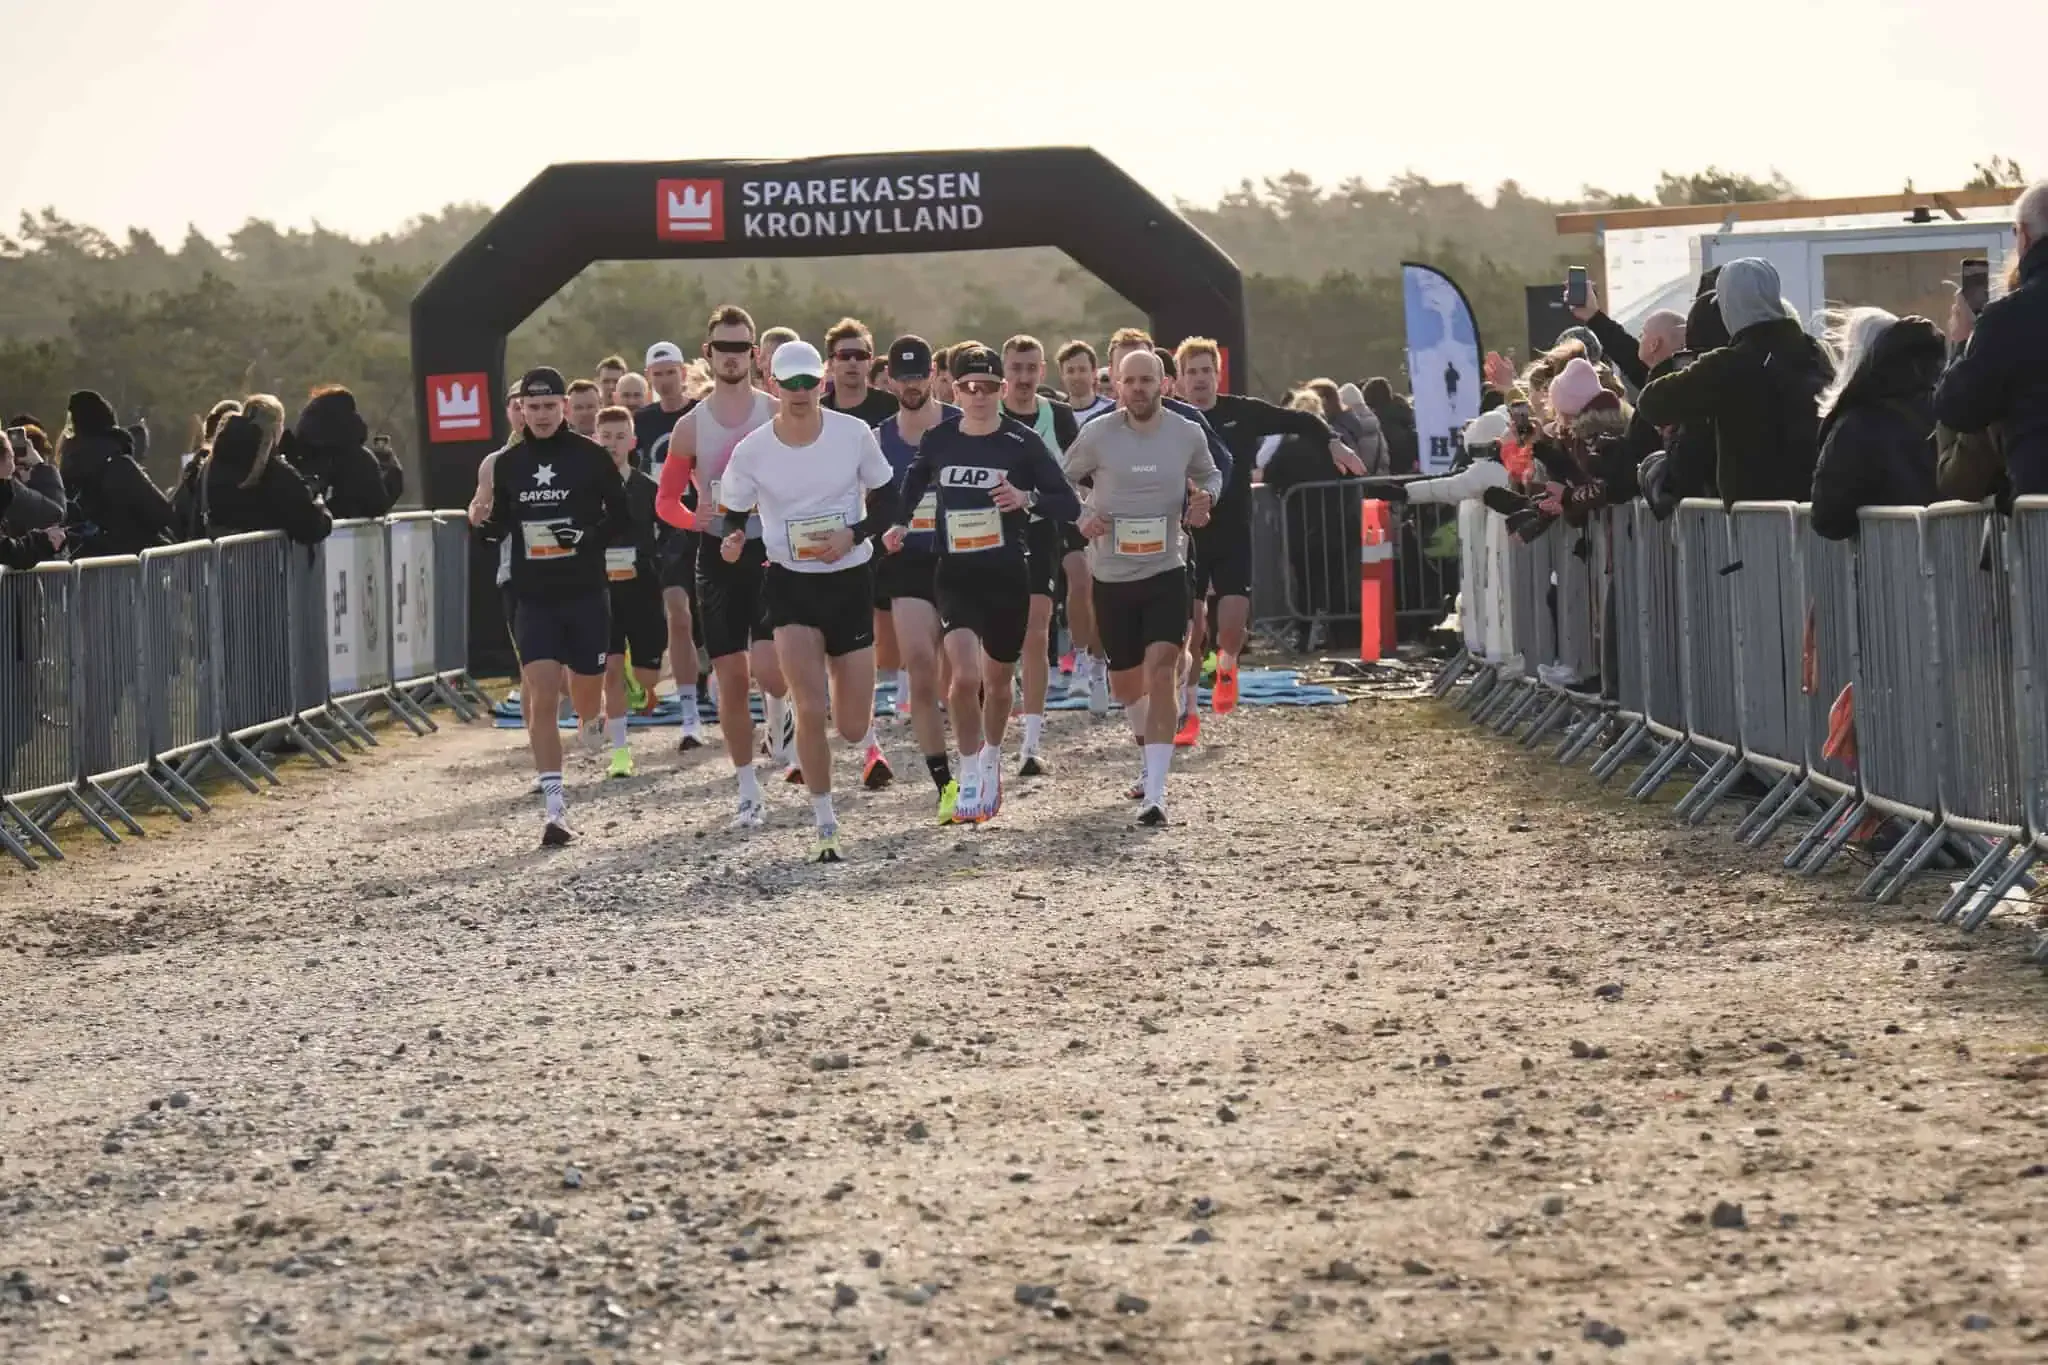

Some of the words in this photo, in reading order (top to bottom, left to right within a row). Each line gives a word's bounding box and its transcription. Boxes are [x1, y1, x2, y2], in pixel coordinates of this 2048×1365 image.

[742, 171, 981, 206] SPAREKASSEN
[743, 204, 984, 237] KRONJYLLAND
[948, 468, 989, 486] LAP
[519, 488, 571, 503] SAYSKY
